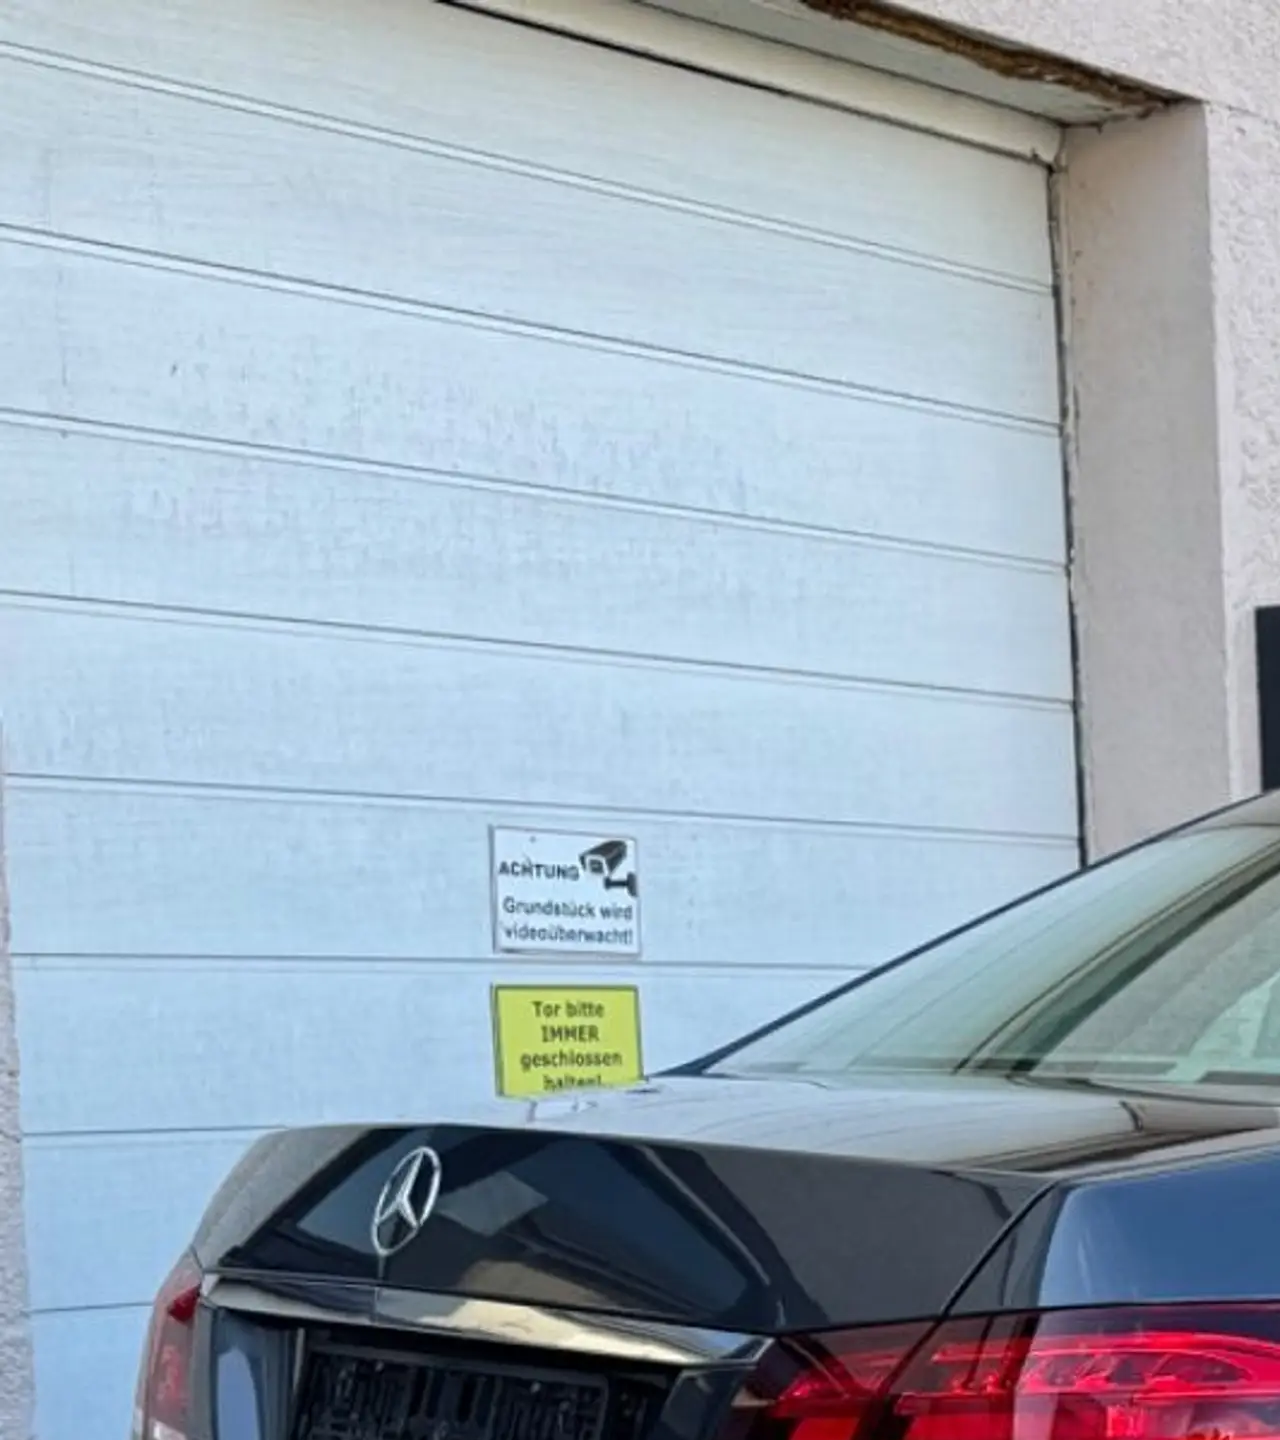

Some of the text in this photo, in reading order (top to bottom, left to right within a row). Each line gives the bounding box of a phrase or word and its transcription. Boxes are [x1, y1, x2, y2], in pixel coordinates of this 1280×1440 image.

[499, 860, 580, 882] ACHTUNG
[502, 896, 633, 921] Grundstück wird
[503, 921, 633, 946] videoüberwacht!
[532, 1000, 605, 1018] Tor bitte
[541, 1025, 599, 1044] IMMER
[520, 1051, 622, 1073] geschlossen
